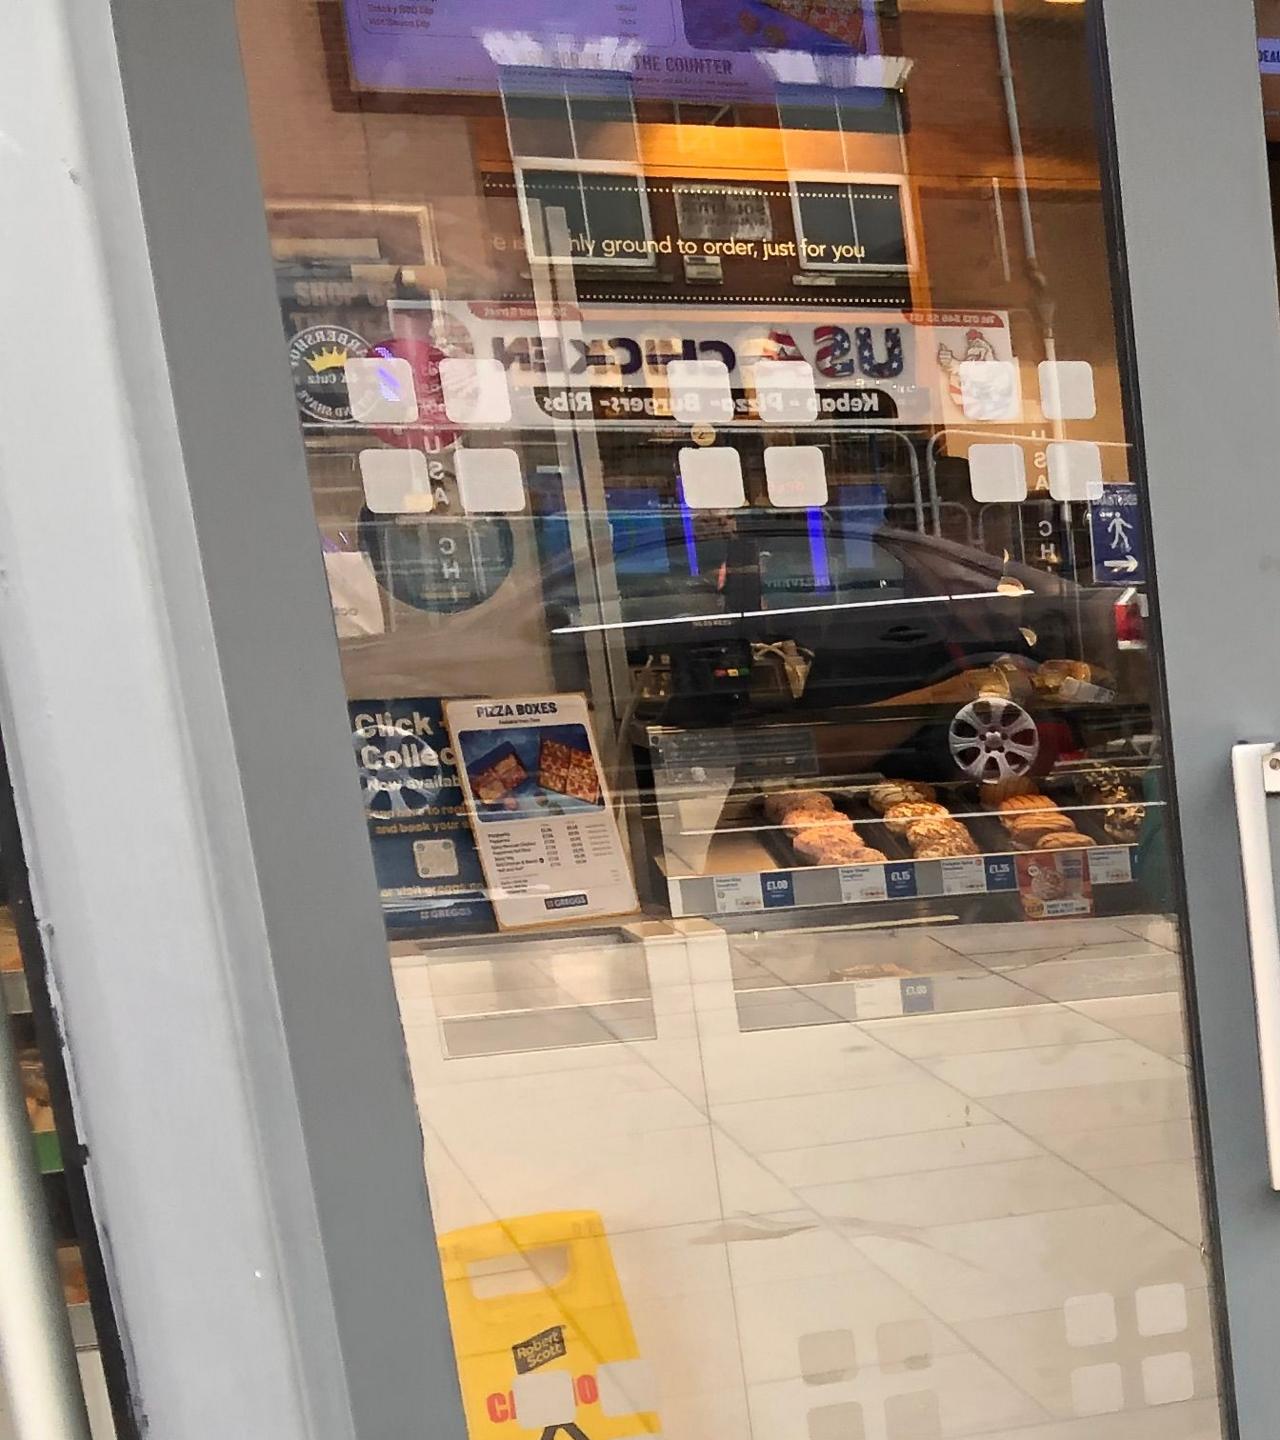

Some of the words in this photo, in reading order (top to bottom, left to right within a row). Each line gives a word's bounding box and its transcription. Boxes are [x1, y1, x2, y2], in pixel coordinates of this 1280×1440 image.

[664, 55, 733, 75] COUNTER
[602, 232, 673, 258] ground
[677, 234, 698, 254] to
[702, 234, 757, 258] order,
[761, 235, 796, 260] just
[798, 235, 826, 257] for
[832, 241, 866, 262] you
[476, 704, 515, 718] PIZZA
[515, 701, 559, 716] BOXES
[354, 711, 434, 739] Click
[360, 743, 455, 770] Collec
[366, 778, 402, 792] Now
[516, 1330, 561, 1360] Robert
[527, 1343, 563, 1369] Scott
